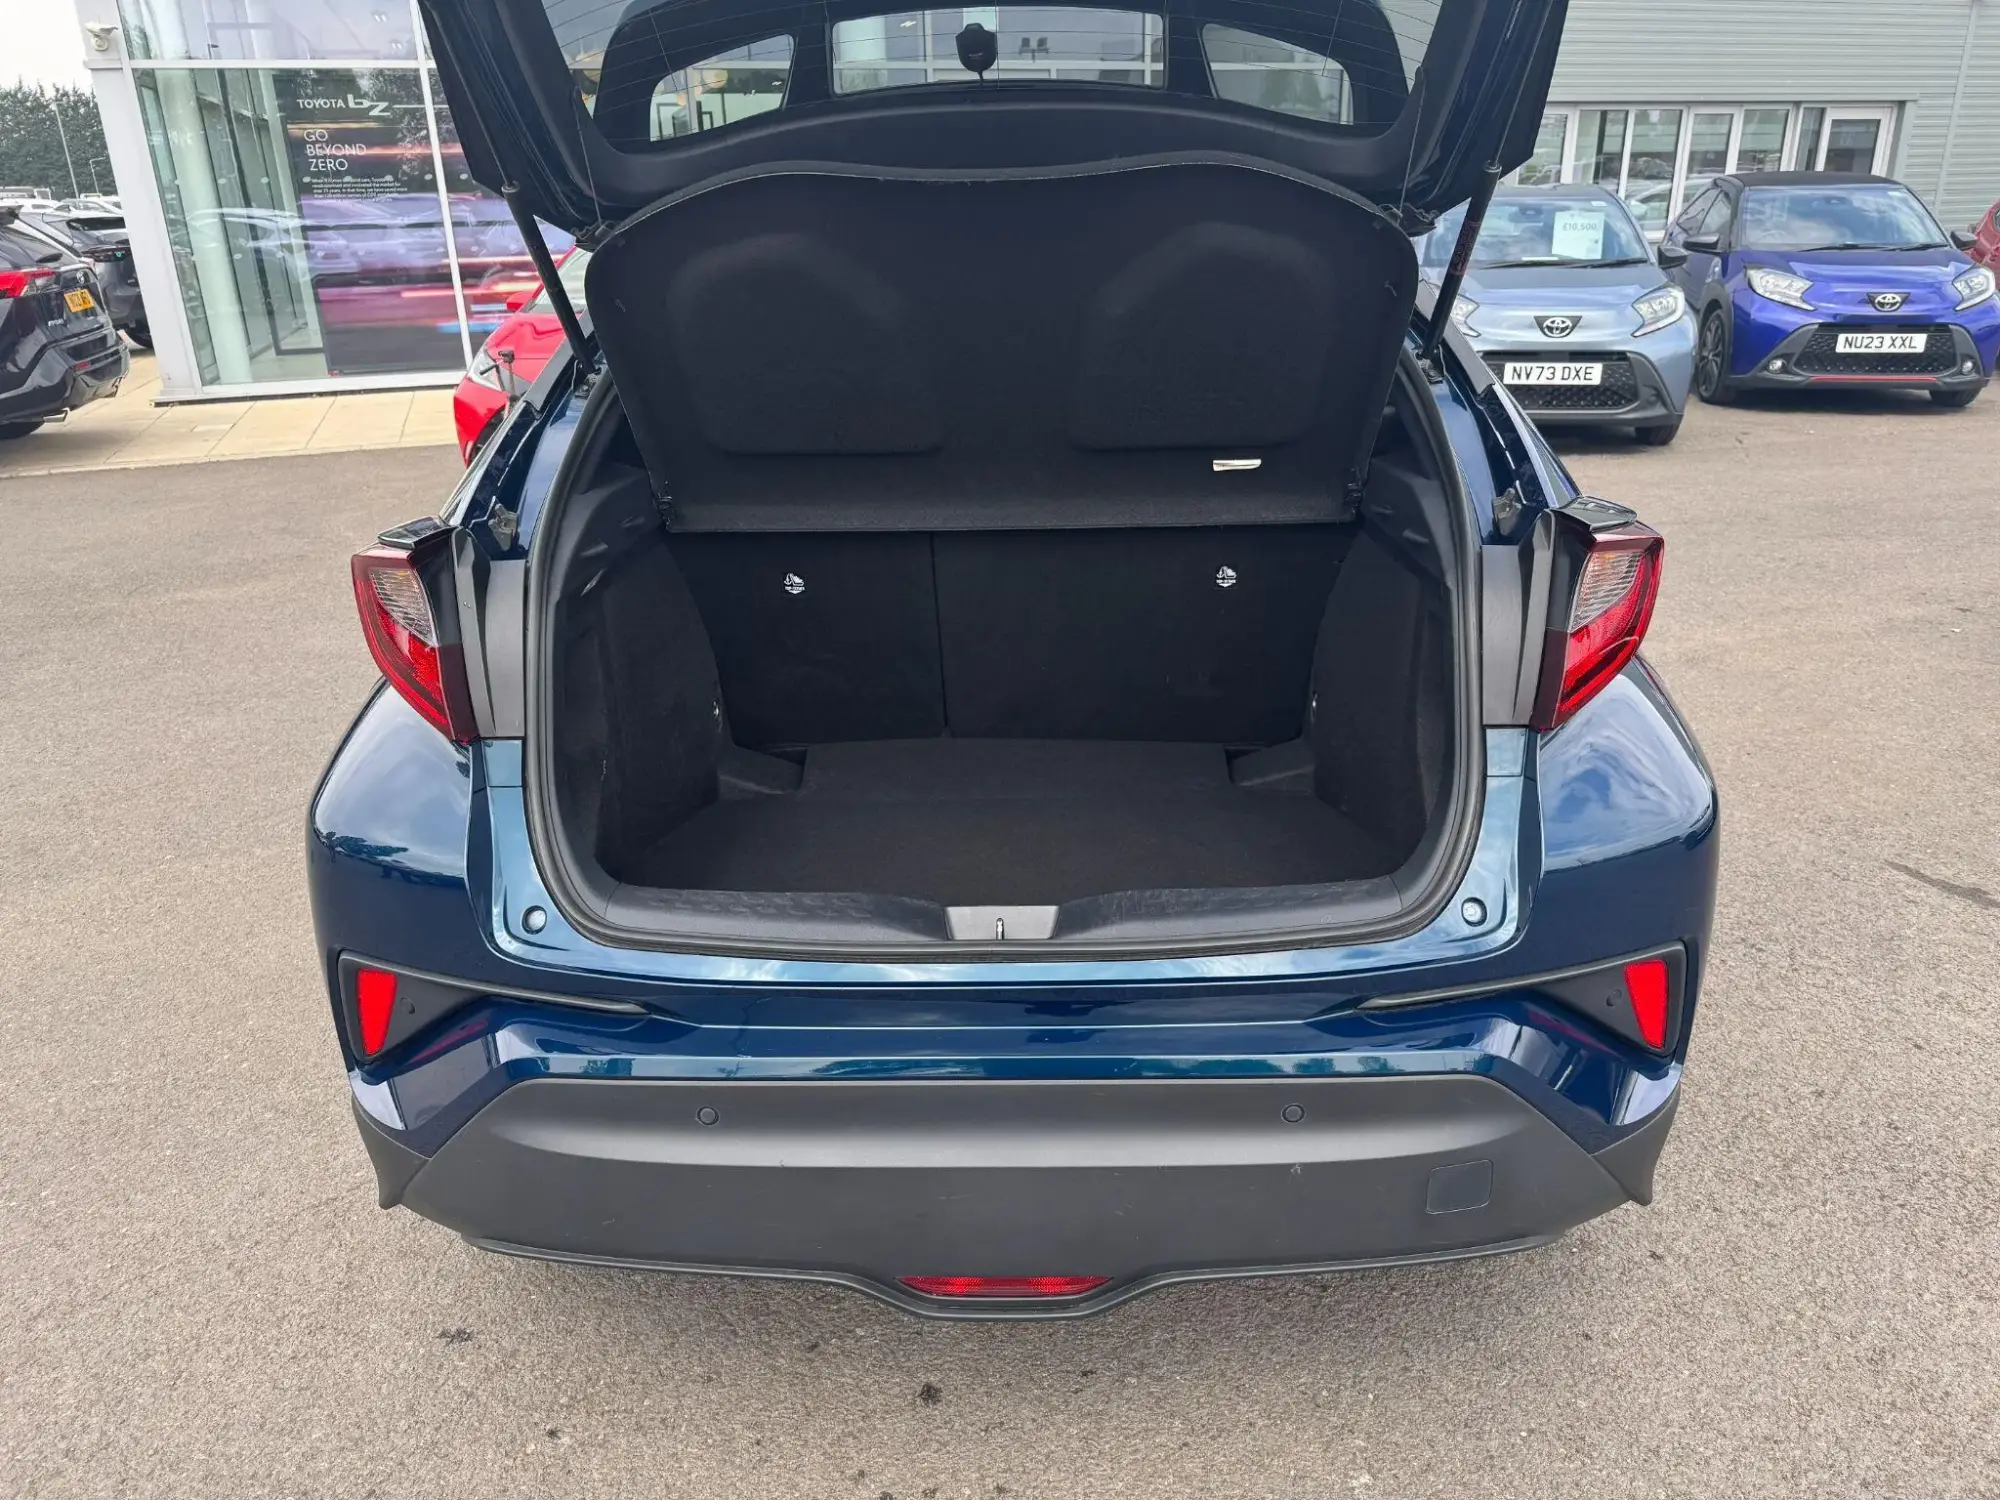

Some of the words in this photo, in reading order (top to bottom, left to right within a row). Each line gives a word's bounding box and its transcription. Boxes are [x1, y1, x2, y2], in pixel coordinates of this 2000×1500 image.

[297, 99, 345, 109] TOYOTA
[303, 129, 329, 142] GO
[306, 143, 367, 156] BEYOND
[308, 158, 349, 171] ZERO
[1843, 336, 1885, 349] NU23
[1888, 336, 1917, 349] XXL
[1512, 366, 1556, 381] NV73
[1561, 366, 1594, 381] DXE
